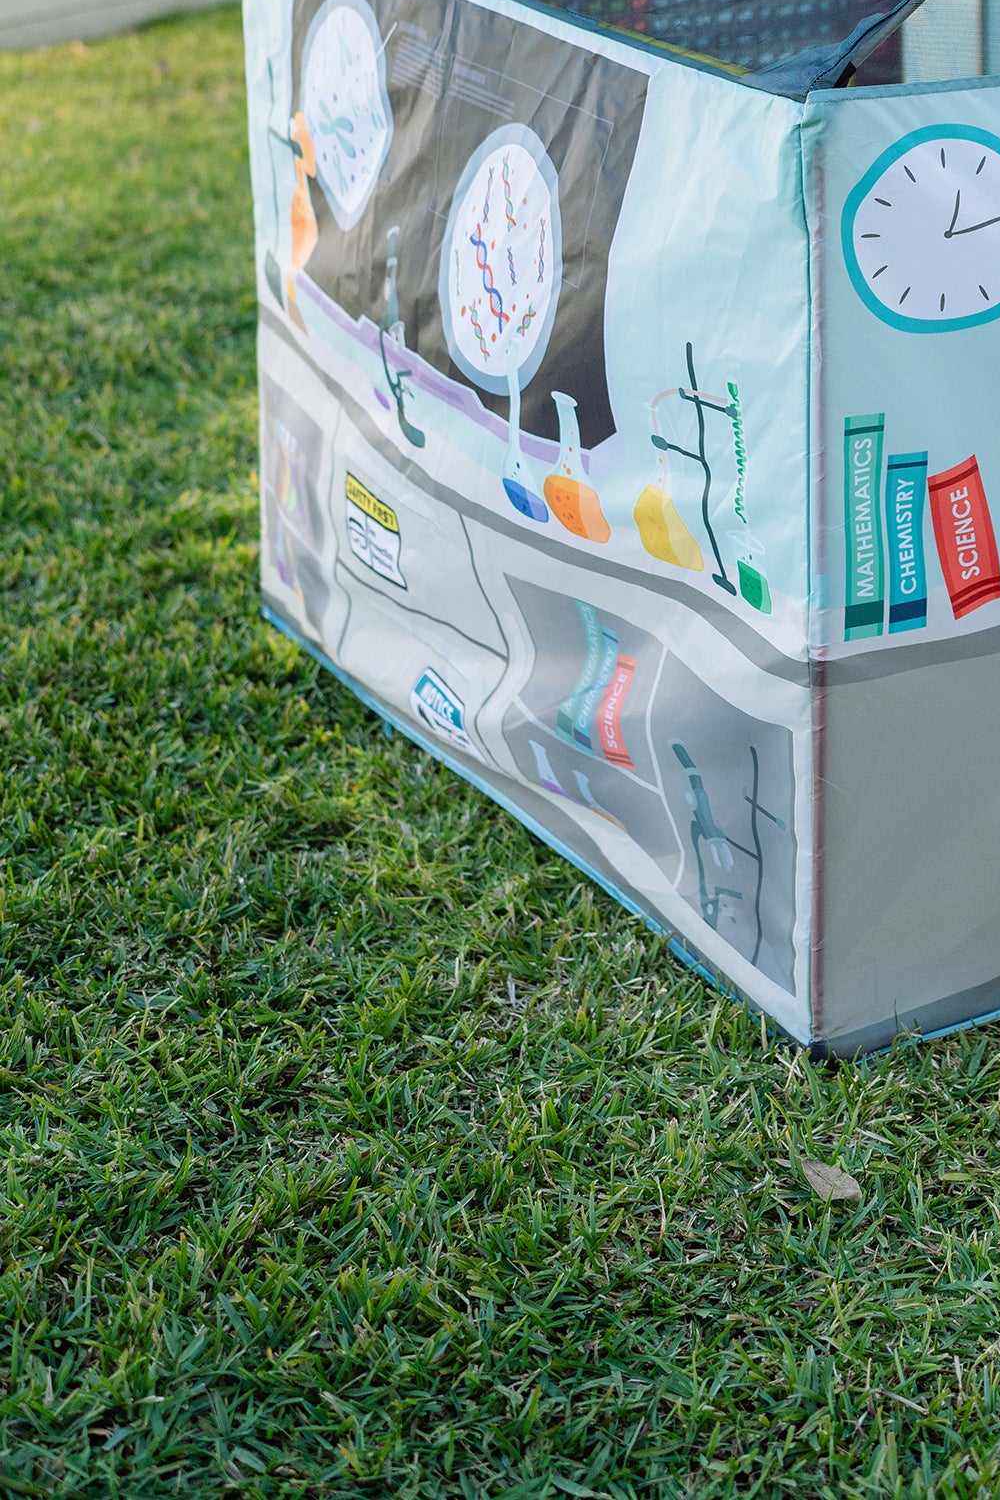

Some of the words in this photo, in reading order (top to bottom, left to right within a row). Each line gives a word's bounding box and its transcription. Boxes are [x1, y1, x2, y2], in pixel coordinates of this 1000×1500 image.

[854, 437, 874, 598] MATHEMATICS
[895, 479, 917, 596] CHEMISTRY
[950, 485, 981, 581] SCIENCE
[604, 673, 629, 749] SCIENCE
